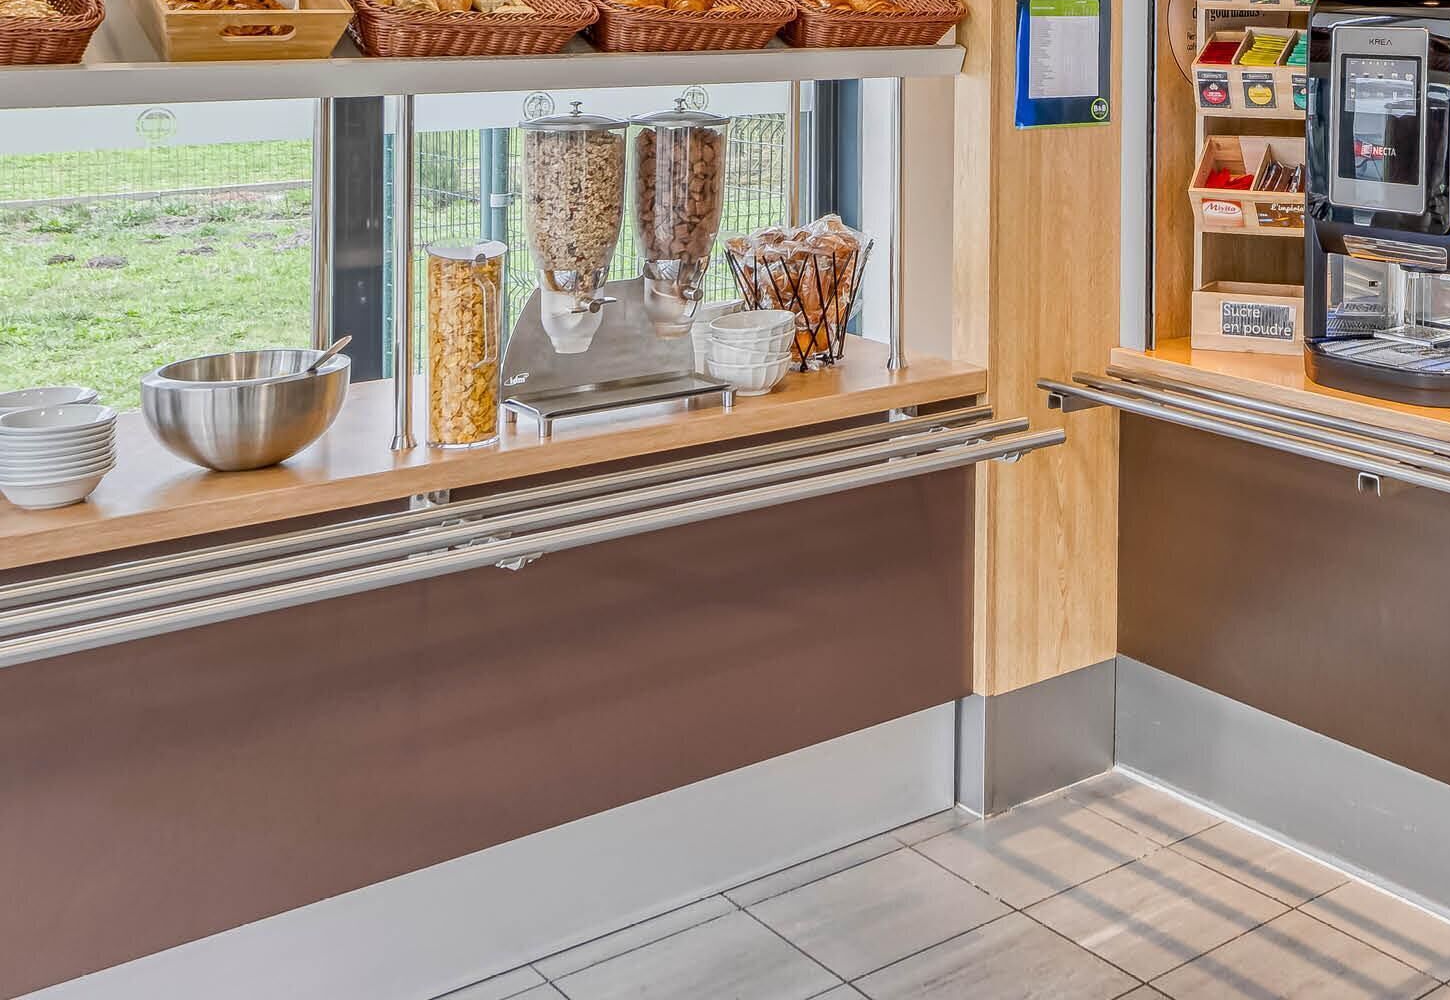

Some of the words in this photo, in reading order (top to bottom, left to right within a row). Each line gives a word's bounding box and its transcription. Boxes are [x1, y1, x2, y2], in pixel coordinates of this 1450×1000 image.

[1372, 146, 1396, 156] NECTA
[1223, 303, 1261, 318] Sucre
[1223, 322, 1240, 333] en
[1243, 323, 1292, 337] poudre
